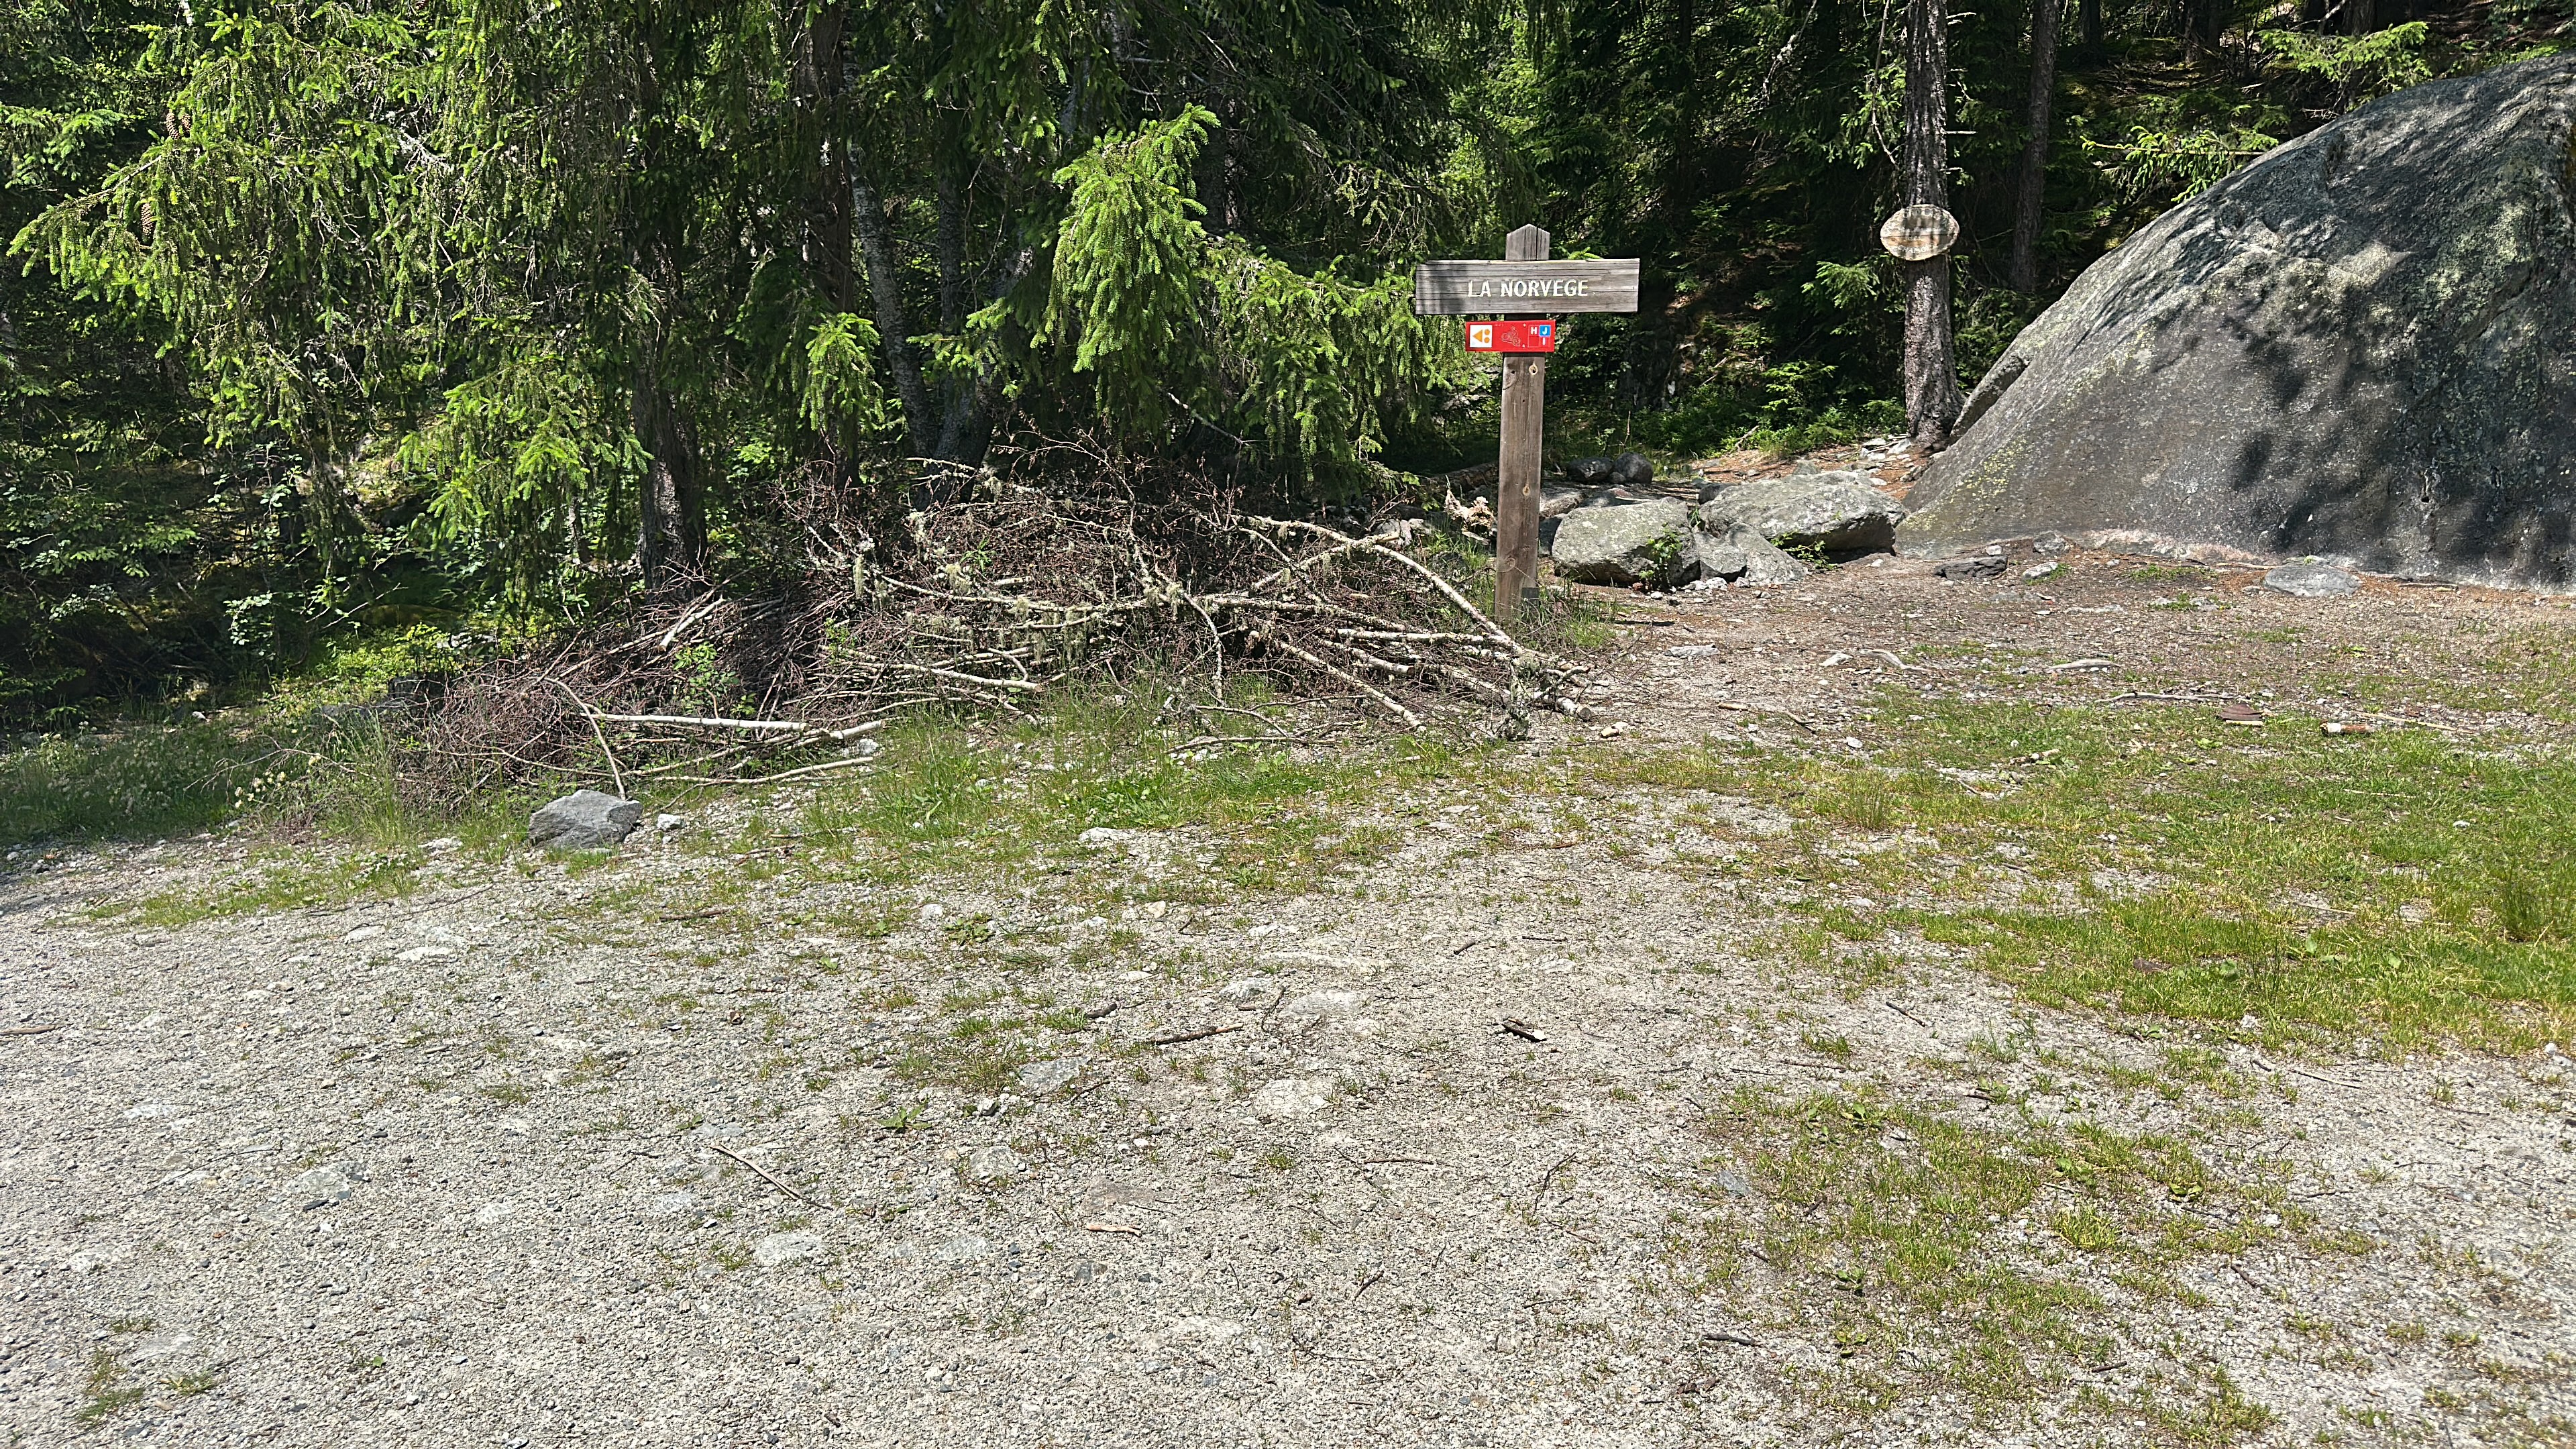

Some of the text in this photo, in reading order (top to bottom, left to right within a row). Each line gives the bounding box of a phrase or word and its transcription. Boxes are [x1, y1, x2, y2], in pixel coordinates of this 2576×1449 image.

[1468, 279, 1589, 297] LA NORVEGE
[1530, 327, 1548, 335] H J
